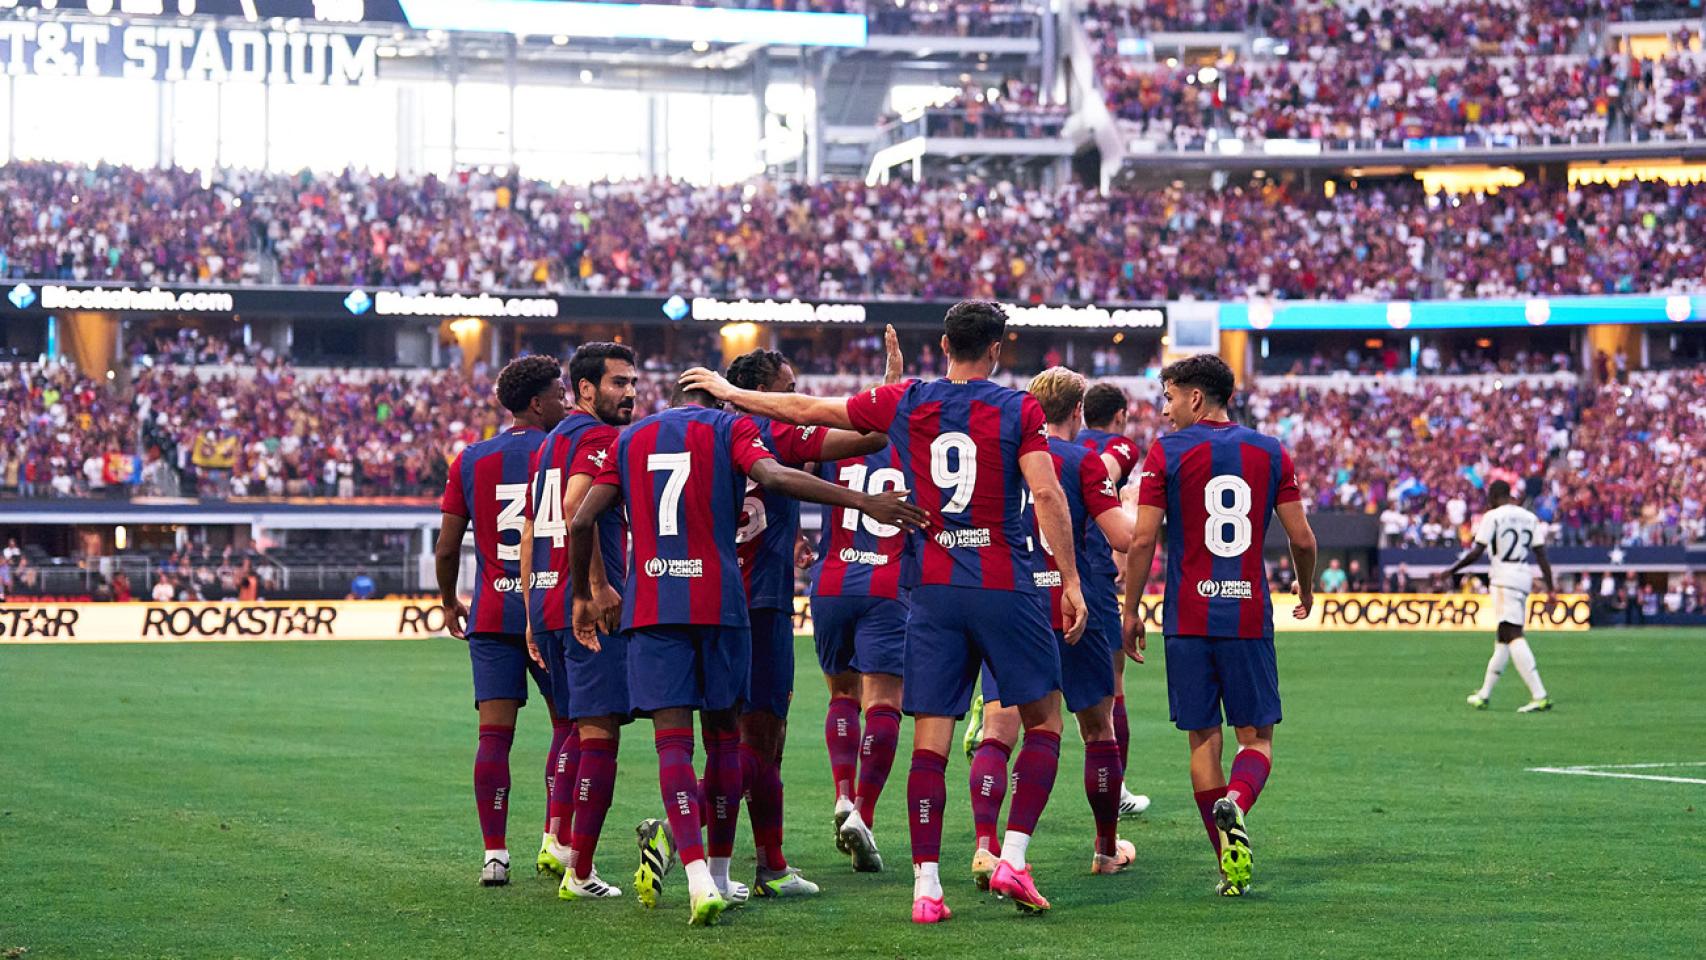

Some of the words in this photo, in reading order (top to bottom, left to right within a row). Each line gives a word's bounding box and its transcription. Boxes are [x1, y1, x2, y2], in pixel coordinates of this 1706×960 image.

[0, 20, 110, 76] T&T
[122, 22, 379, 85] STADIUM
[930, 431, 977, 513] 9
[647, 451, 691, 536] 7
[495, 483, 528, 561] 3
[1204, 474, 1252, 558] 8
[956, 528, 990, 537] UNHCR
[957, 535, 991, 544] ACNUR
[668, 559, 703, 567] UNHCR
[1221, 580, 1252, 588] UNHCR
[1221, 587, 1252, 596] ACNUR
[142, 606, 337, 637] ROCKSTAR
[399, 605, 447, 633] RO
[1320, 599, 1480, 625] ROCKSTAR
[920, 798, 932, 824] BARÇA
